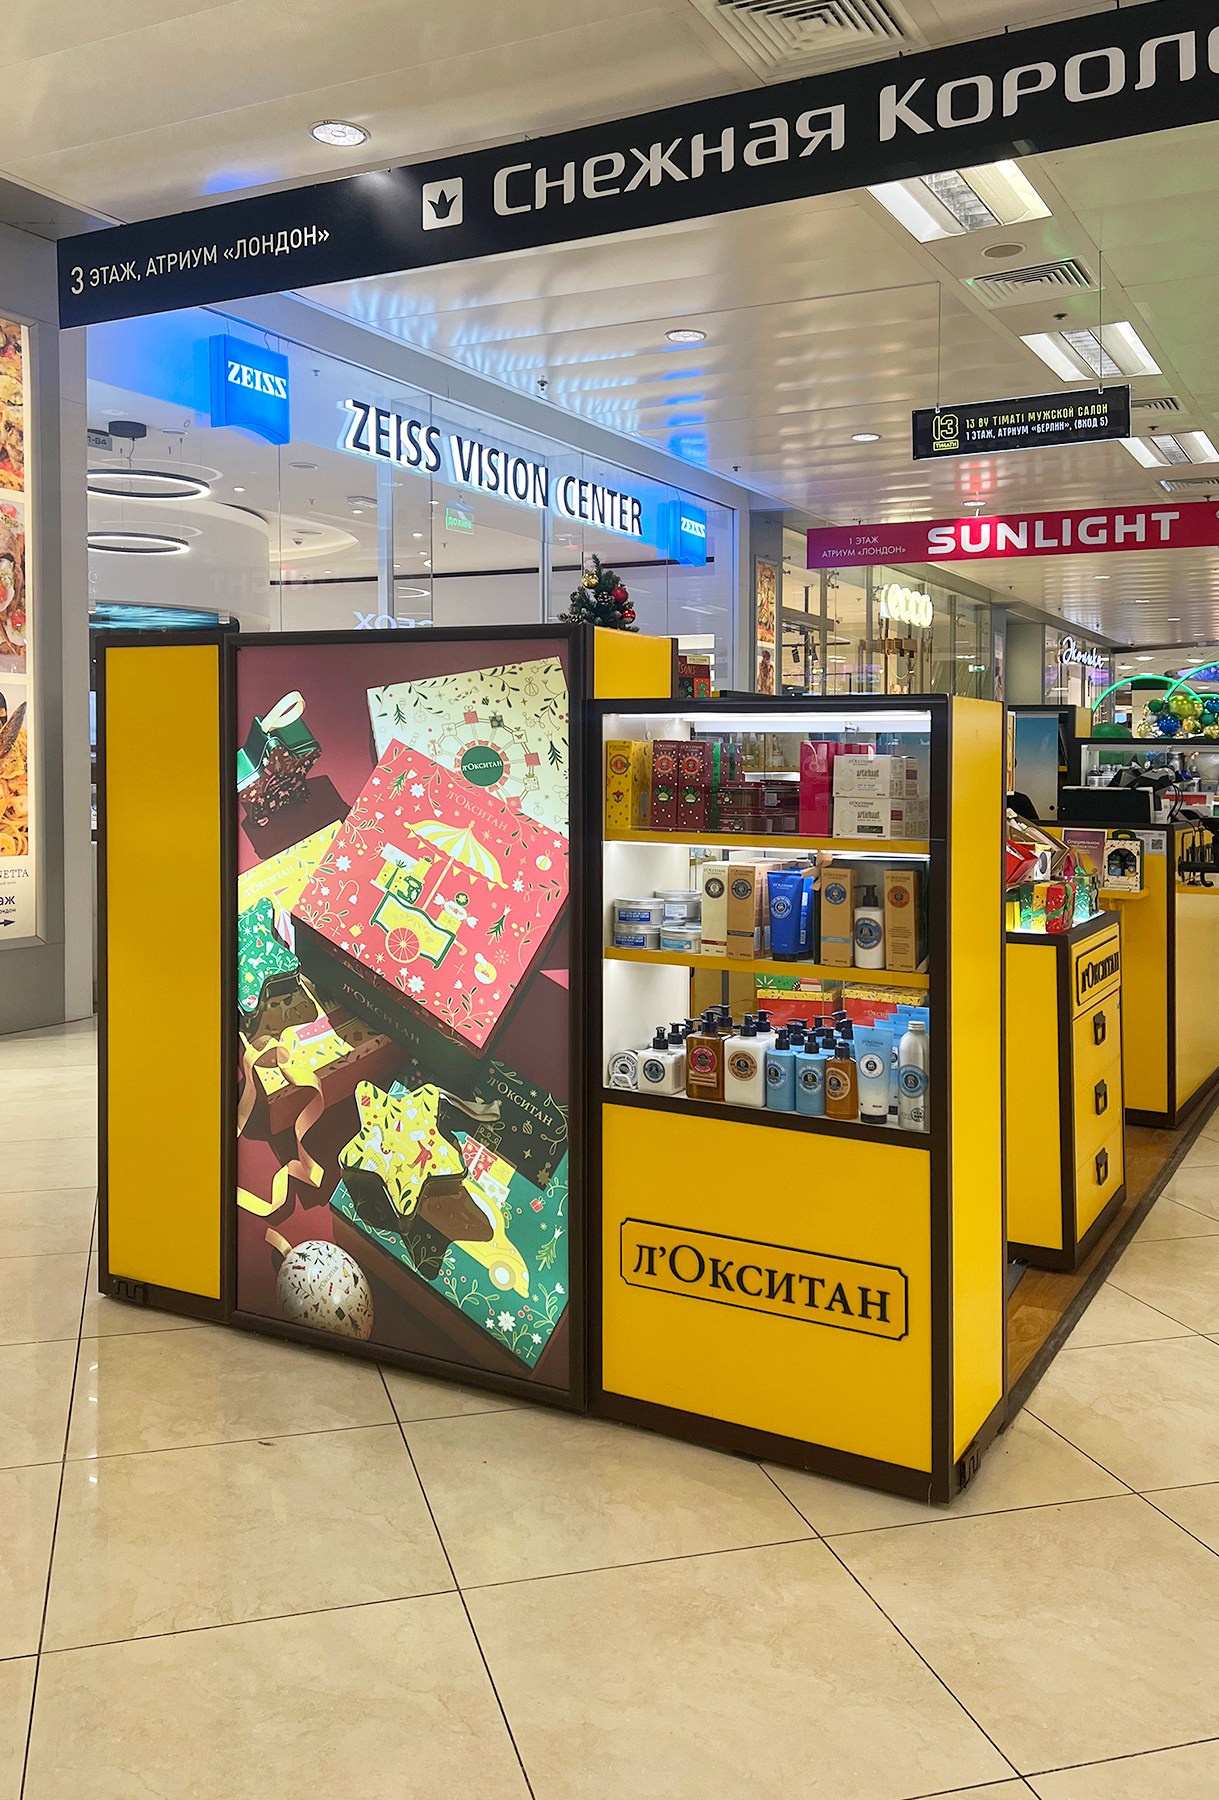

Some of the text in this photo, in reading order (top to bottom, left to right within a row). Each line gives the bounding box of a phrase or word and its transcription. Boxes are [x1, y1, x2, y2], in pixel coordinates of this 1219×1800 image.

[493, 25, 1219, 217] Снежная Корол
[70, 224, 330, 295] 3 ЭТАЖ, АТРИУМ «ЛОНДОН»
[227, 360, 287, 400] ZEISS
[932, 413, 959, 440] 13
[965, 418, 975, 429] 13
[1027, 404, 1075, 422] МУЖСКОЙ
[1077, 403, 1108, 417] САЛОН
[997, 425, 1029, 438] АТРИУМ
[344, 398, 643, 537] ZEISS VISION CENTER
[681, 517, 705, 538] ZEISS
[848, 535, 880, 546] 1 ЭТАЖ
[927, 511, 1180, 555] SUNLIGHT
[821, 544, 907, 559] АТРИУМ «ЛОНДОН»
[633, 1243, 891, 1323] Л'ОКСИТАН
